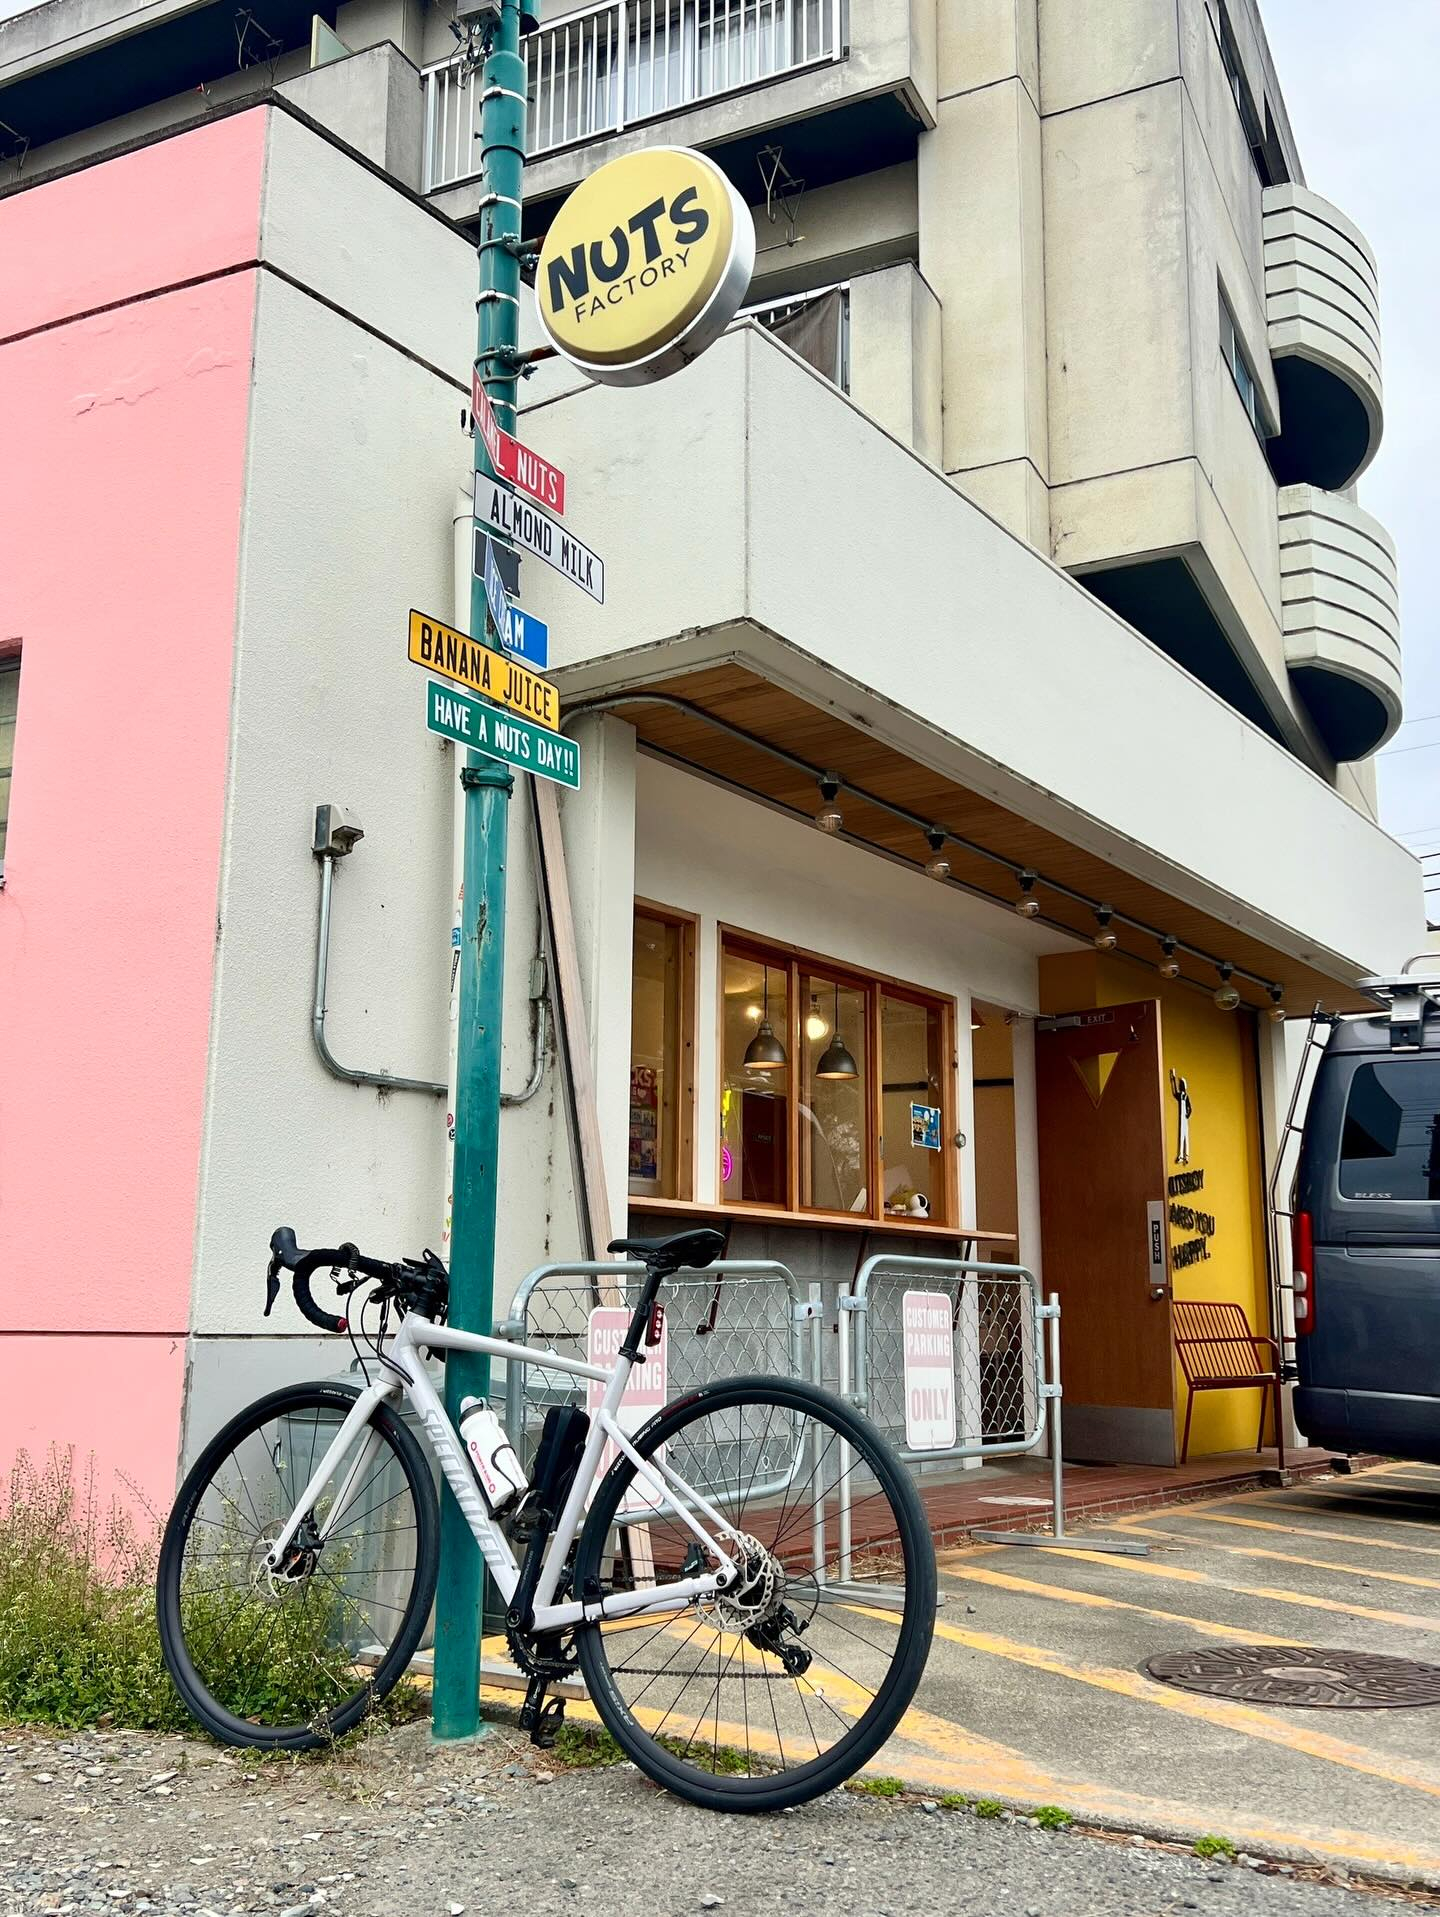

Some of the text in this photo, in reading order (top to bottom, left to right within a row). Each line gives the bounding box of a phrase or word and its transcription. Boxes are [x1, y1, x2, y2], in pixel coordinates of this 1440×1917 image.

[547, 186, 709, 314] NUTS
[575, 247, 690, 323] FACTORY
[517, 449, 557, 504] NUTS
[490, 489, 551, 557] ALMOND
[561, 536, 593, 589] MILK
[421, 623, 551, 722] BANANA JUICE
[434, 693, 574, 777] HAVE A NUTS DAY!!
[1087, 1014, 1106, 1024] EXIT
[906, 1307, 949, 1329] CUSTOMER
[907, 1334, 950, 1357] PARKING
[911, 1388, 949, 1422] ONLY
